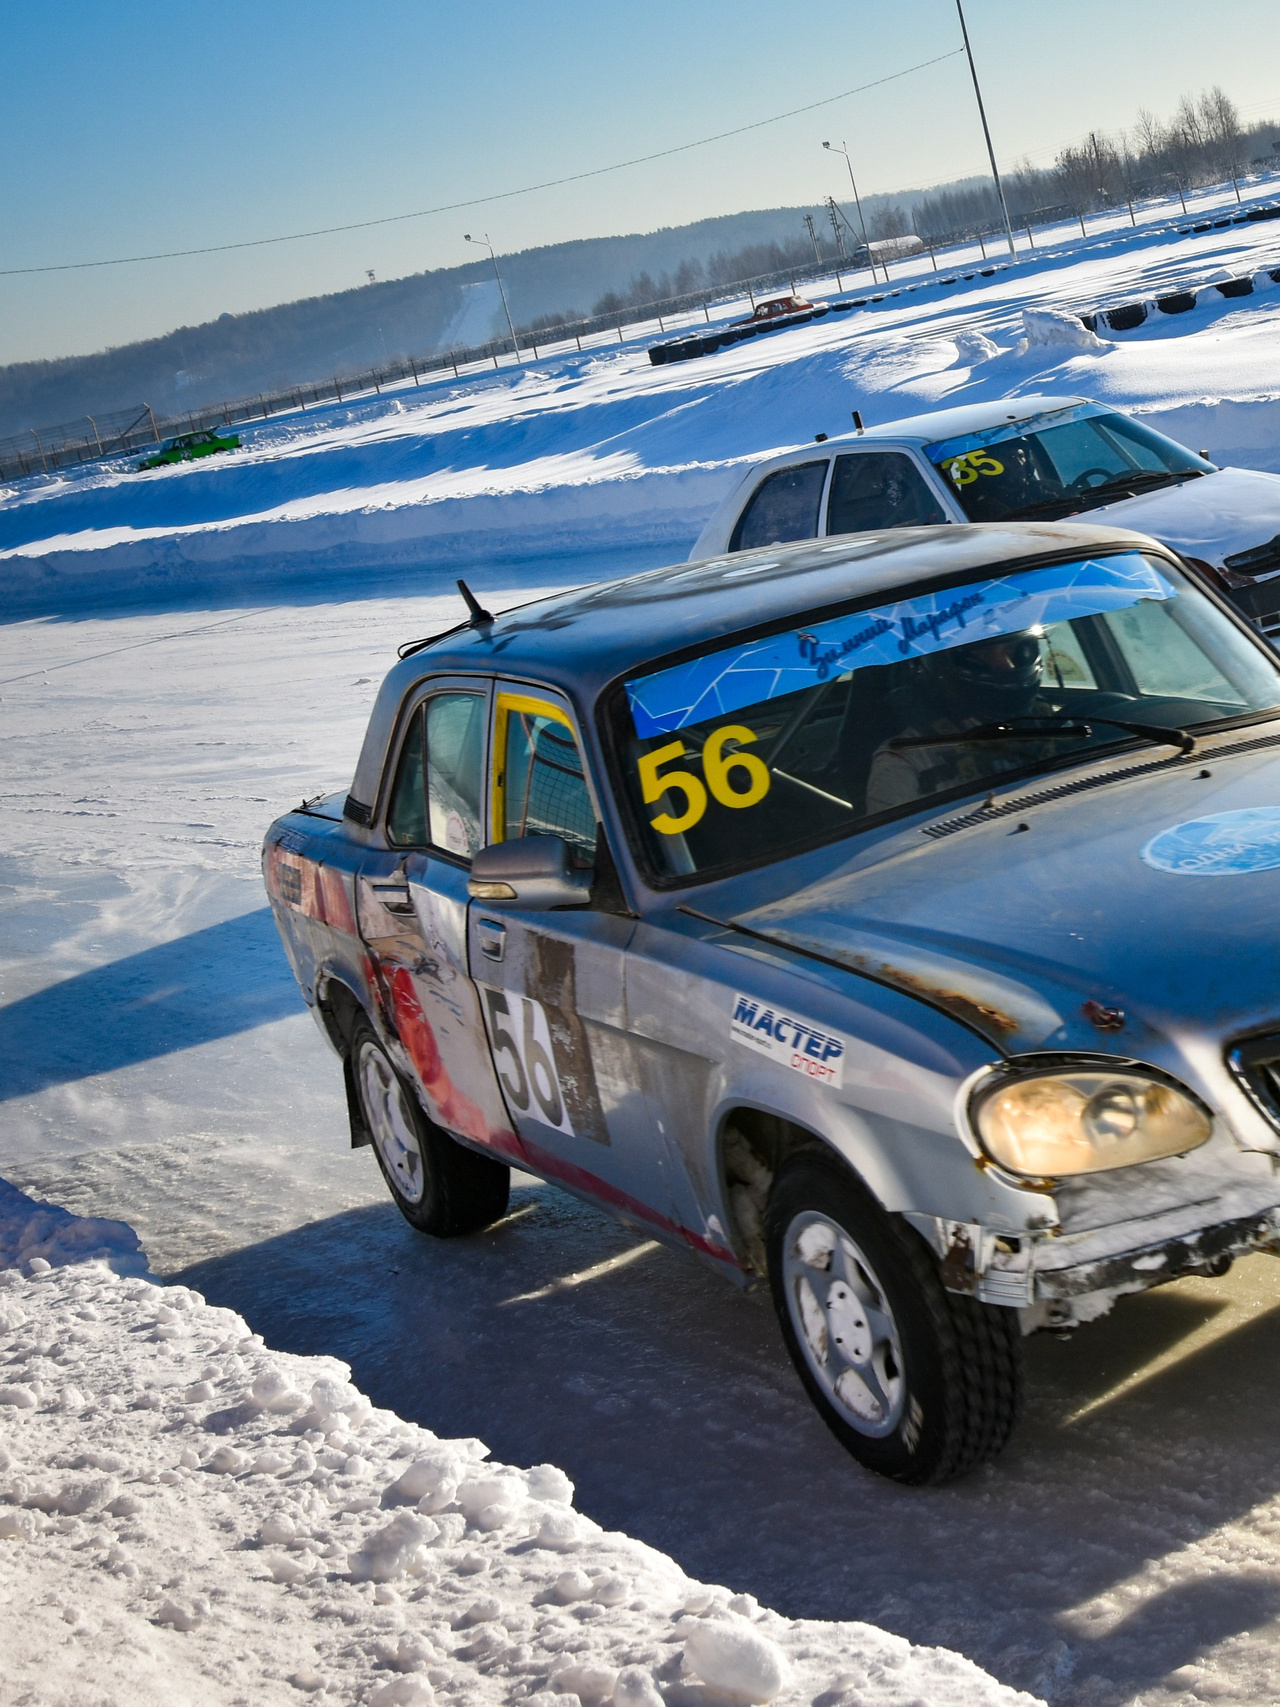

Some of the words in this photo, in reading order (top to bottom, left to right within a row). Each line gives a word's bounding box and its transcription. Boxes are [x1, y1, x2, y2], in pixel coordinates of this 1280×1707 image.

[941, 450, 1005, 485] 35
[797, 617, 895, 679] Зимний
[898, 592, 985, 655] Марафон
[637, 725, 771, 835] 56
[484, 987, 564, 1128] 56
[732, 997, 845, 1063] МАСТЕР
[790, 1053, 837, 1083] СПОРТ
